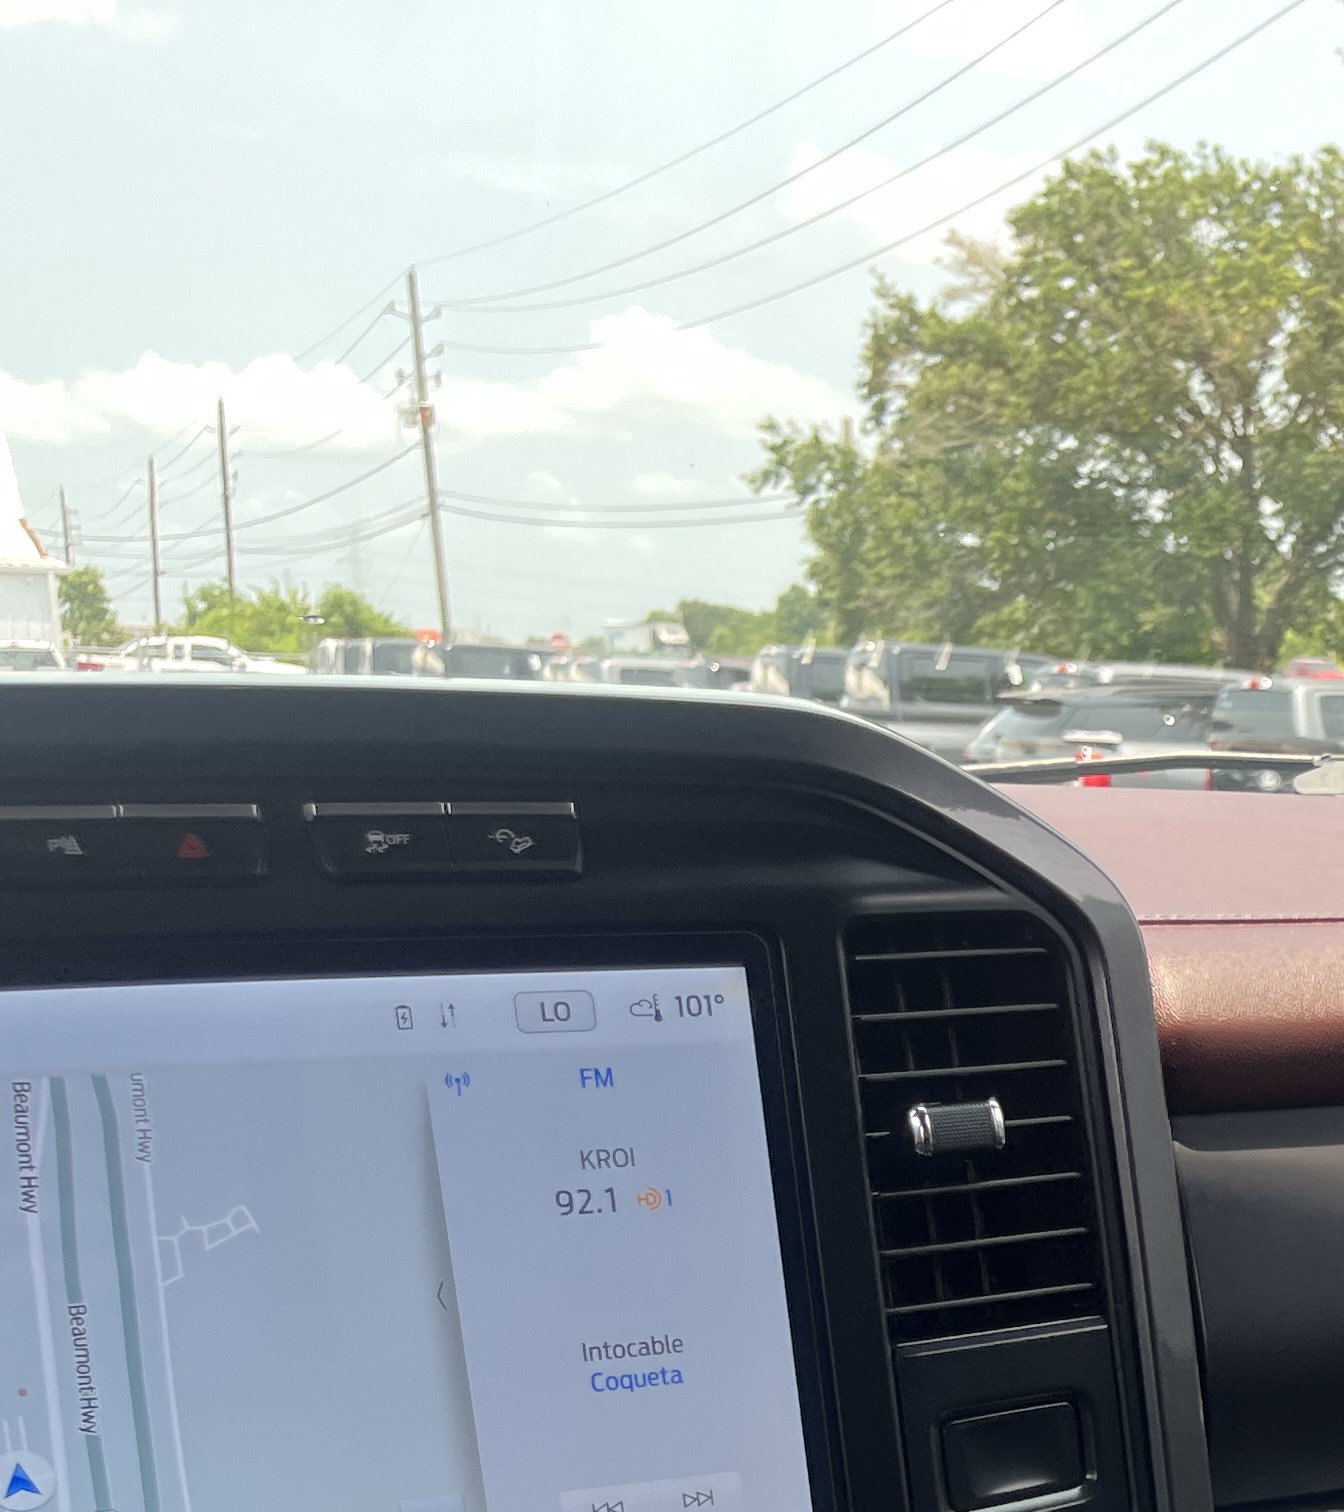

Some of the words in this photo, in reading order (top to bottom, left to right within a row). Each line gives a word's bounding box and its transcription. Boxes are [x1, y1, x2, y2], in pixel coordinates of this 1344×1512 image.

[386, 834, 410, 845] OFF
[540, 1001, 571, 1023] LO
[580, 1068, 614, 1089] FM
[12, 1081, 35, 1172] Beaumont
[136, 1129, 152, 1163] Hwy
[579, 1148, 636, 1169] KROI
[18, 1175, 38, 1215] Hwy
[554, 1188, 618, 1216] 92.1
[69, 1304, 94, 1394] Beaumont
[581, 1333, 684, 1363] Intocable
[590, 1366, 684, 1393] Coqueta
[76, 1395, 98, 1436] Hwy
